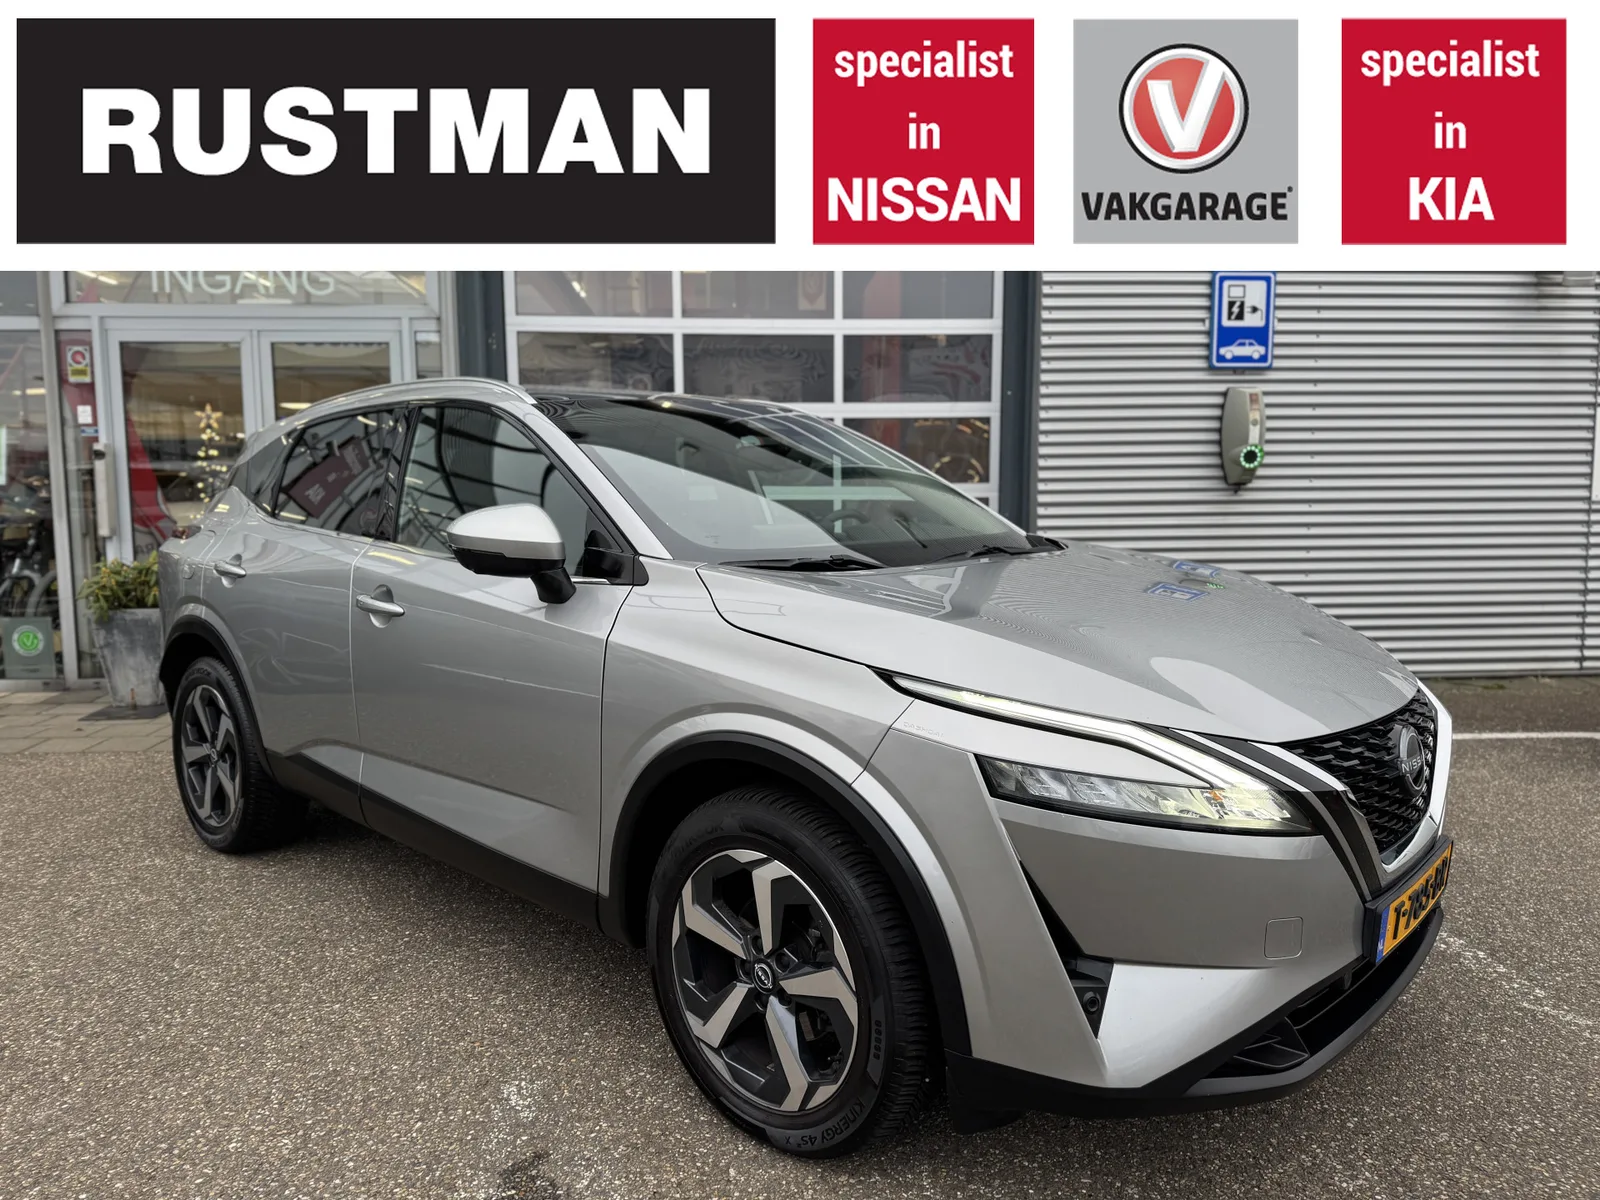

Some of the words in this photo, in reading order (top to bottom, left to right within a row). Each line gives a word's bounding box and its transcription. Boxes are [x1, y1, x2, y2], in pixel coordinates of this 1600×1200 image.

[151, 271, 336, 295] INGANG
[1401, 755, 1422, 773] NISS
[821, 1096, 866, 1143] KINERGY
